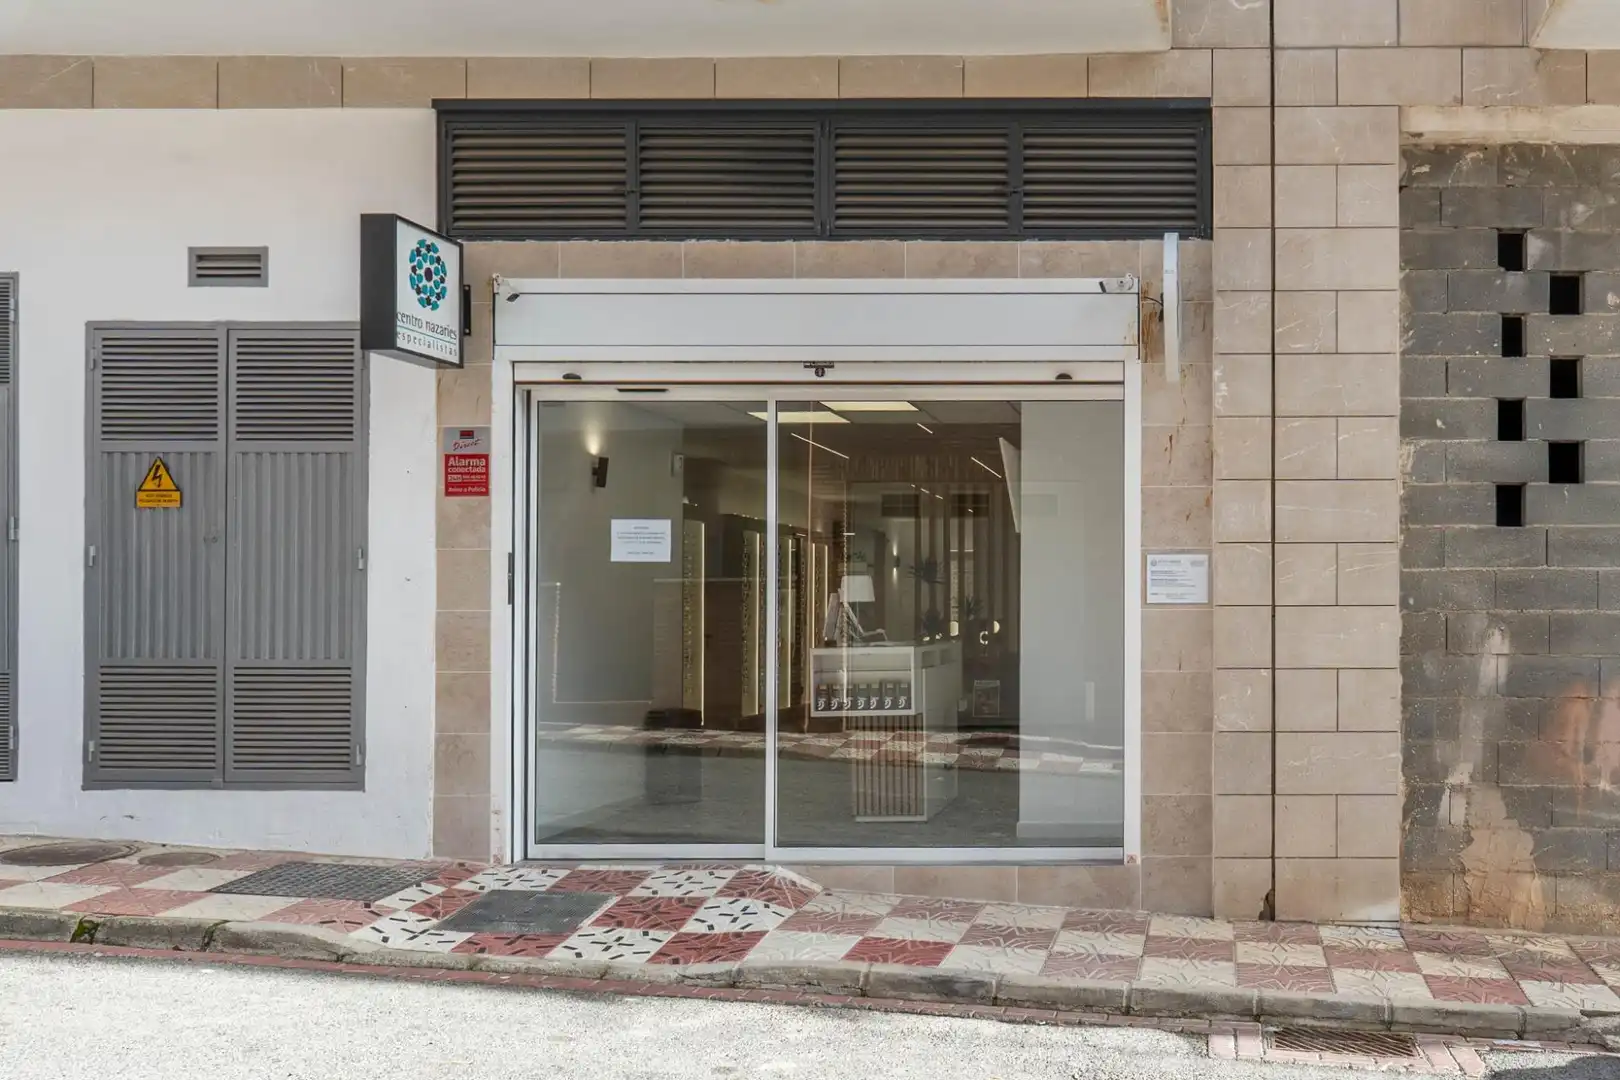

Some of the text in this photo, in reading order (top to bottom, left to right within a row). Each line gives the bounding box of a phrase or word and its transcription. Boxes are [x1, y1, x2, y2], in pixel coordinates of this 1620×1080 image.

[396, 312, 423, 329] centro
[396, 332, 457, 356] especialistas
[453, 438, 482, 451] Direct
[448, 456, 485, 466] Alarma
